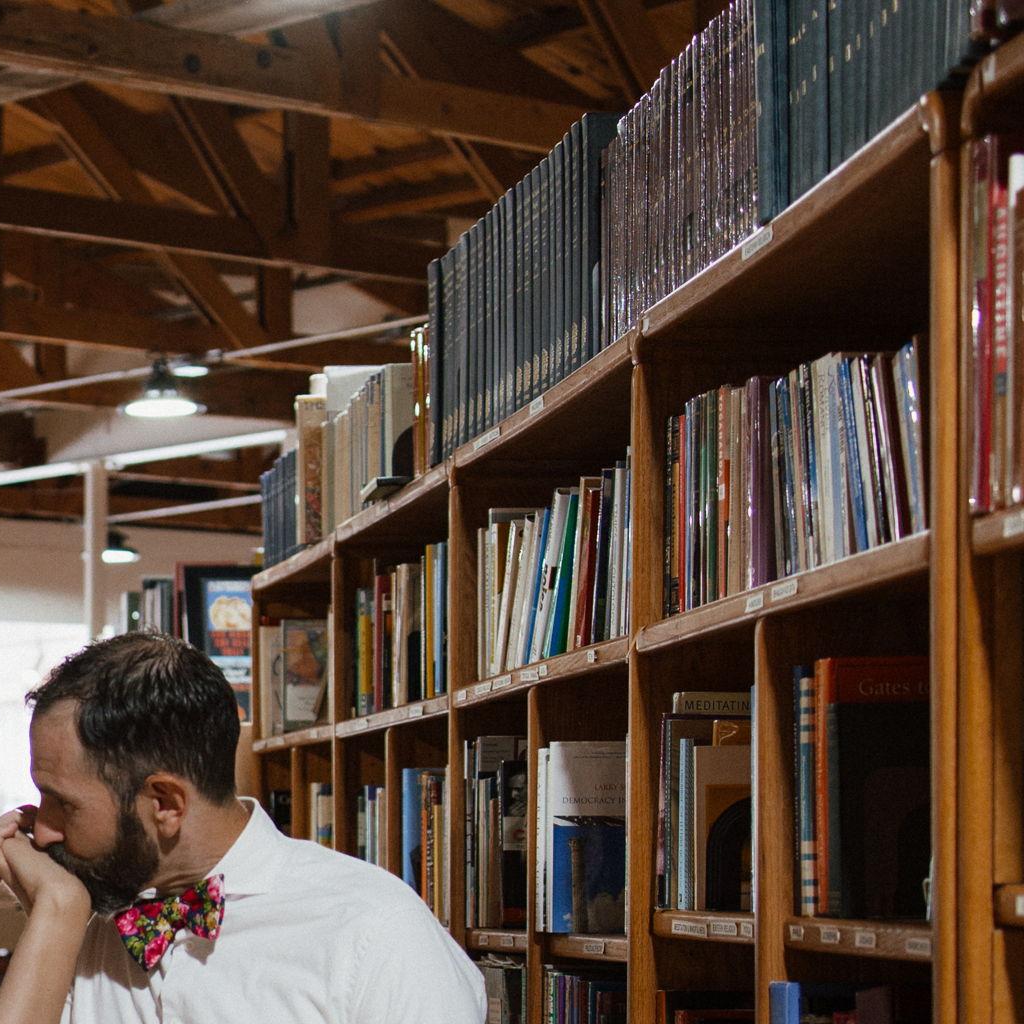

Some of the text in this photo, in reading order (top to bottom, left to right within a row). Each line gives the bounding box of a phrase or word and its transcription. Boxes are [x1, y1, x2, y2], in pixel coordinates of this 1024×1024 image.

[859, 680, 910, 696] Gates
[684, 700, 751, 711] MEDITATIN
[562, 797, 616, 805] DEMOCRACY
